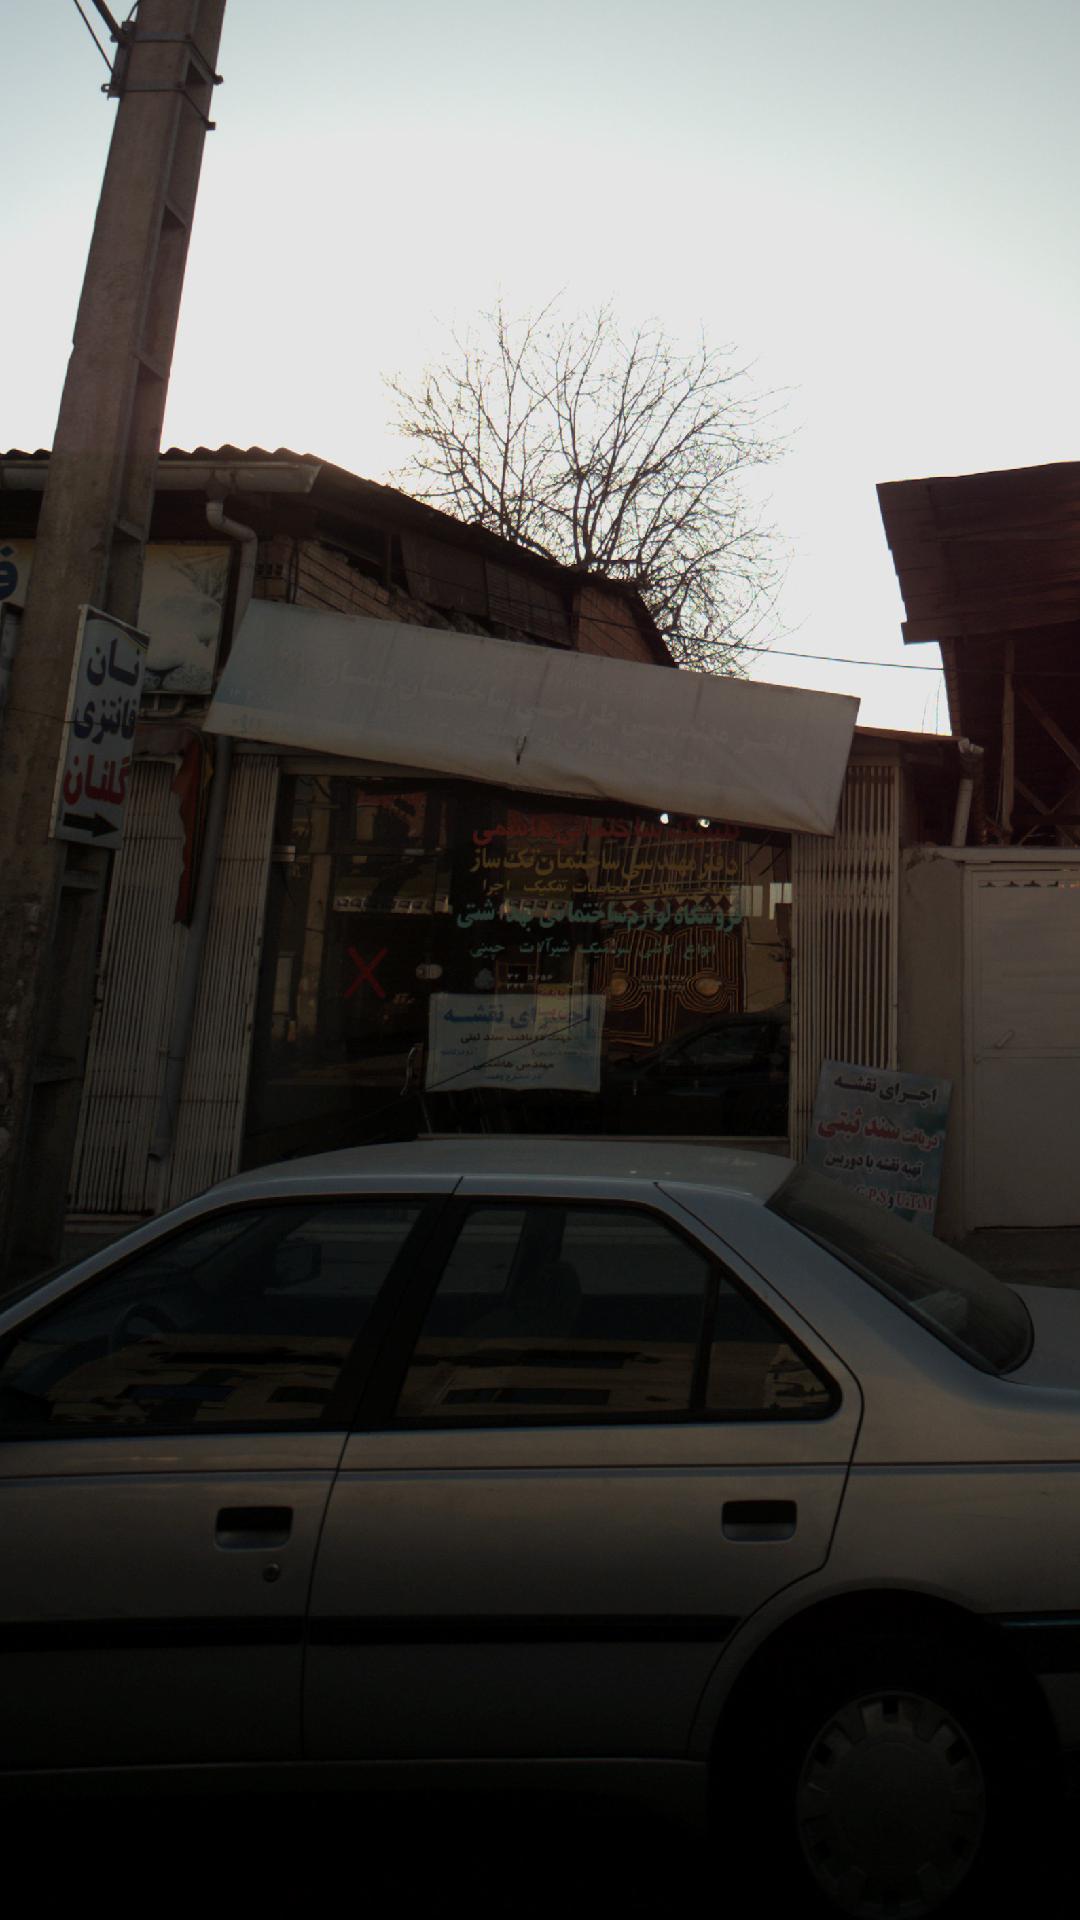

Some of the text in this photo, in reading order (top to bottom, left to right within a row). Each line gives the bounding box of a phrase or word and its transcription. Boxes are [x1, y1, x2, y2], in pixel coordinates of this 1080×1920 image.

[86, 638, 141, 687] نان
[73, 696, 137, 745] فانتزی
[469, 847, 506, 873] ساز
[535, 848, 620, 875] ساختمان
[622, 853, 697, 881] مهندسی
[455, 897, 536, 932] بهداشتی
[539, 898, 629, 929] ساختمانی
[627, 900, 672, 932] لوازم
[675, 899, 743, 933] فروشگاه
[834, 1075, 938, 1107] اجرای نقشه
[817, 1107, 863, 1139] ثبتی
[864, 1117, 901, 1141] سند
